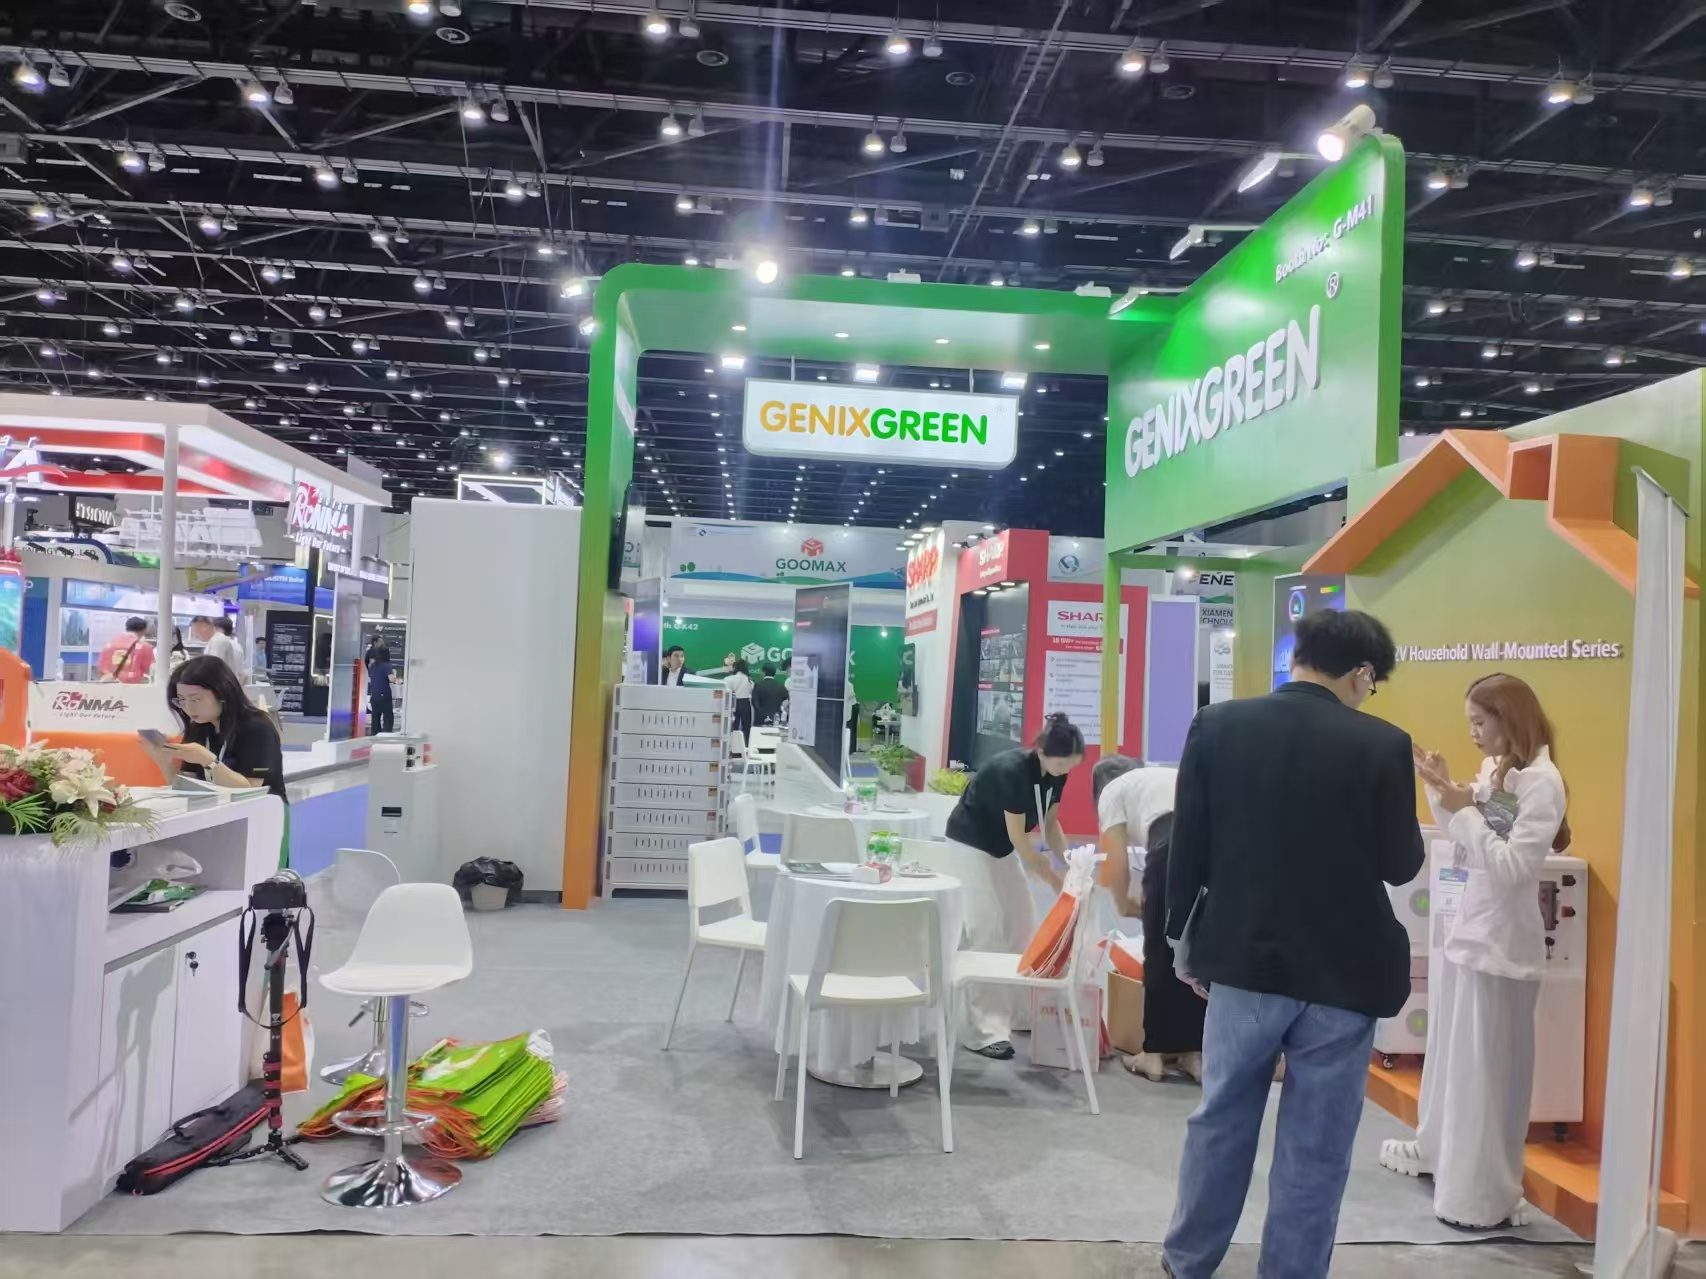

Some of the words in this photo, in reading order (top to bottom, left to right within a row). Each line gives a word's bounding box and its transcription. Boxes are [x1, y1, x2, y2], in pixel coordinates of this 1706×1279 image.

[1333, 195, 1372, 240] G-M41
[1124, 304, 1320, 478] GENIXGREEN
[760, 400, 988, 445] GENIXGREEN
[776, 558, 847, 573] GOOMAX
[1057, 610, 1104, 622] SHAR
[1202, 608, 1233, 618] XIAMEN
[1409, 643, 1468, 662] Household
[1471, 640, 1568, 661] Wall-Mounted
[1571, 637, 1620, 659] Series
[52, 690, 129, 712] RONMA
